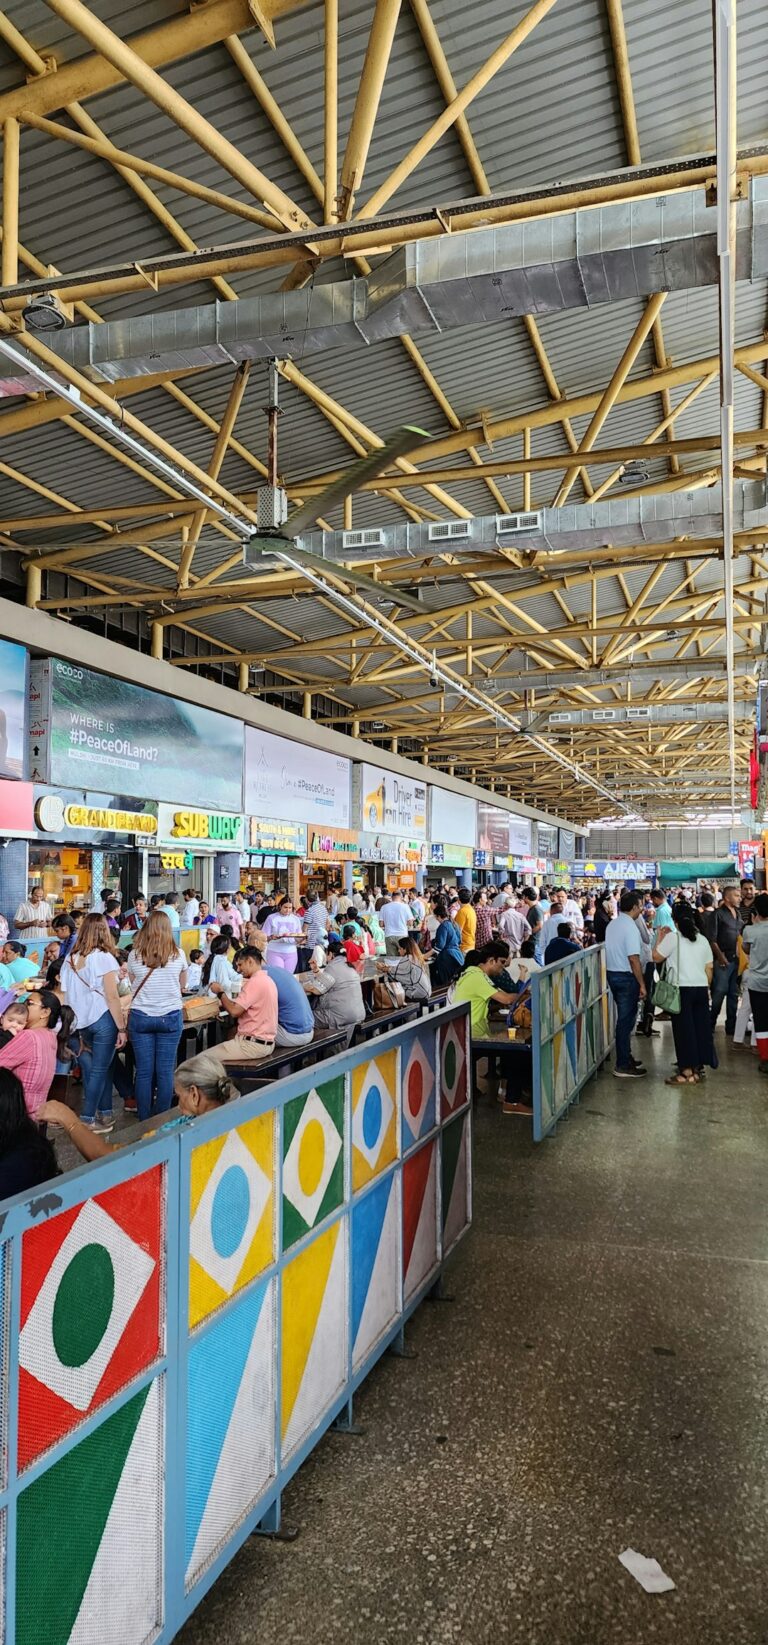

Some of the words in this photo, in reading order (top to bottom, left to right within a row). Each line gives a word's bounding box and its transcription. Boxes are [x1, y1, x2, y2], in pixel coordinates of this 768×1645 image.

[56, 663, 84, 680] ecoco
[69, 712, 104, 731] WHERE
[106, 722, 115, 733] IS
[69, 728, 159, 761] #PeaceOfLand?
[297, 779, 336, 797] #PeaceOfLand
[393, 780, 413, 807] Driver
[172, 812, 241, 840] SUBWAY
[160, 849, 193, 870] सबवे
[604, 862, 646, 874] AJFAN
